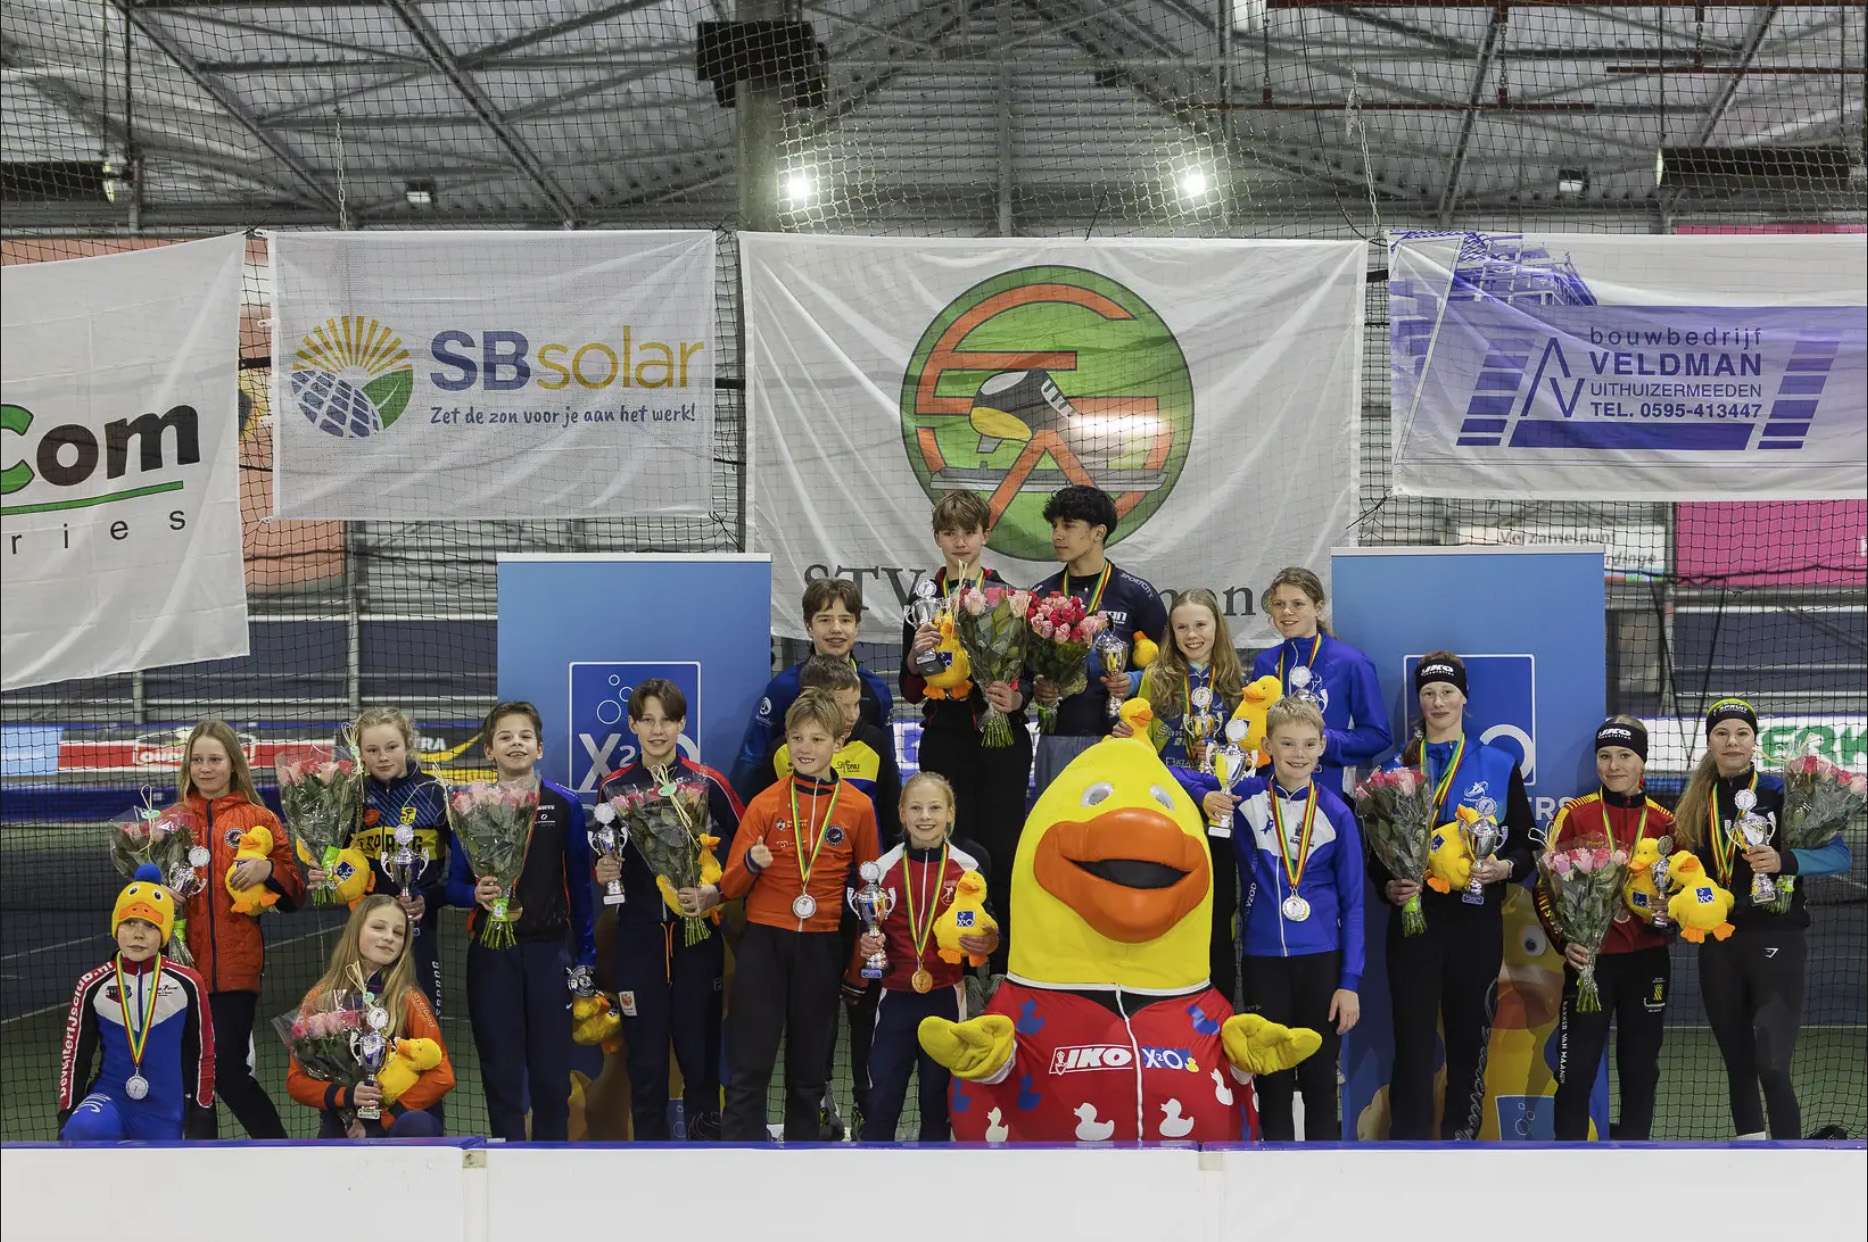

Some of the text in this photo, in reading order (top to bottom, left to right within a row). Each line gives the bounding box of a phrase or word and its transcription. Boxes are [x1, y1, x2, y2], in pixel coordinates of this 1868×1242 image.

[1590, 327, 1762, 349] bouwbedrijf
[1589, 351, 1762, 376] VELDMAN
[1590, 382, 1762, 398] UITHUIZERMEEDEN
[430, 403, 696, 428] Zet de zon voor je aan het werk!
[1590, 402, 1763, 418] TEL. 0595-413447
